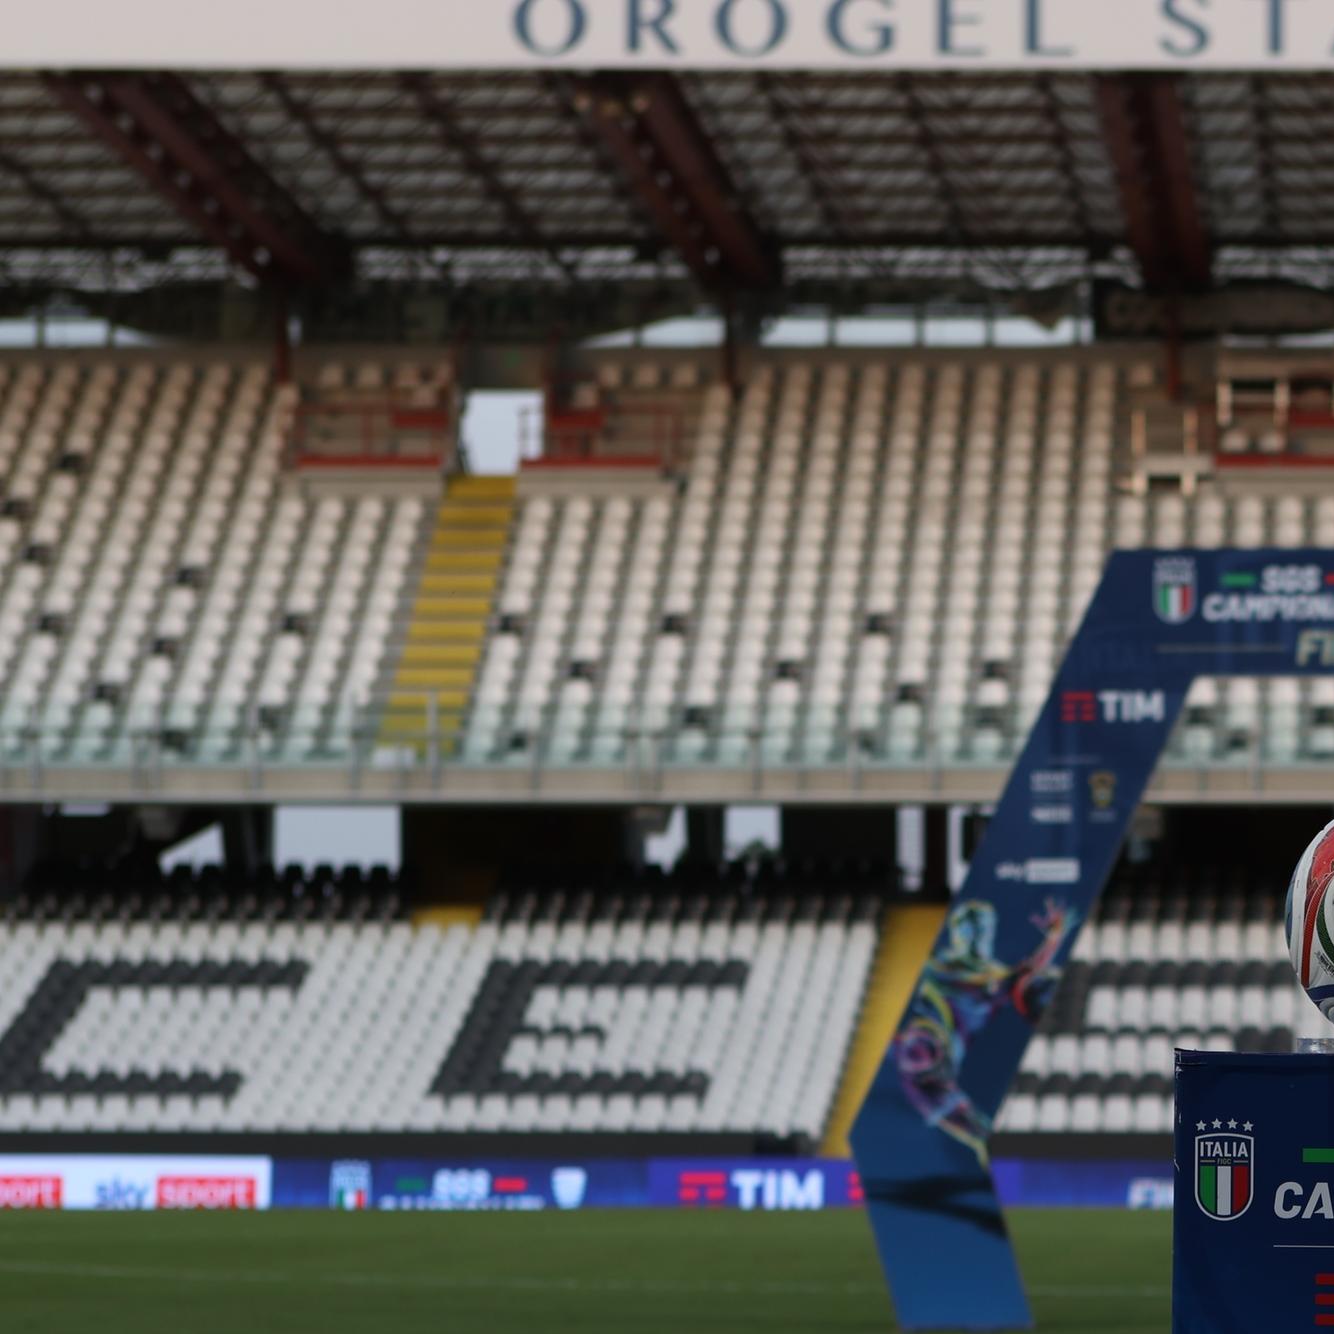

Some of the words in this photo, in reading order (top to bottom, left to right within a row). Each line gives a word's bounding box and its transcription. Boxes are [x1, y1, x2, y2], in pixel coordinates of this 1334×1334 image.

[512, 0, 1077, 57] OROGEL
[1097, 690, 1165, 722] TIM
[1200, 1141, 1249, 1158] ITALIA
[731, 1169, 824, 1209] TIM
